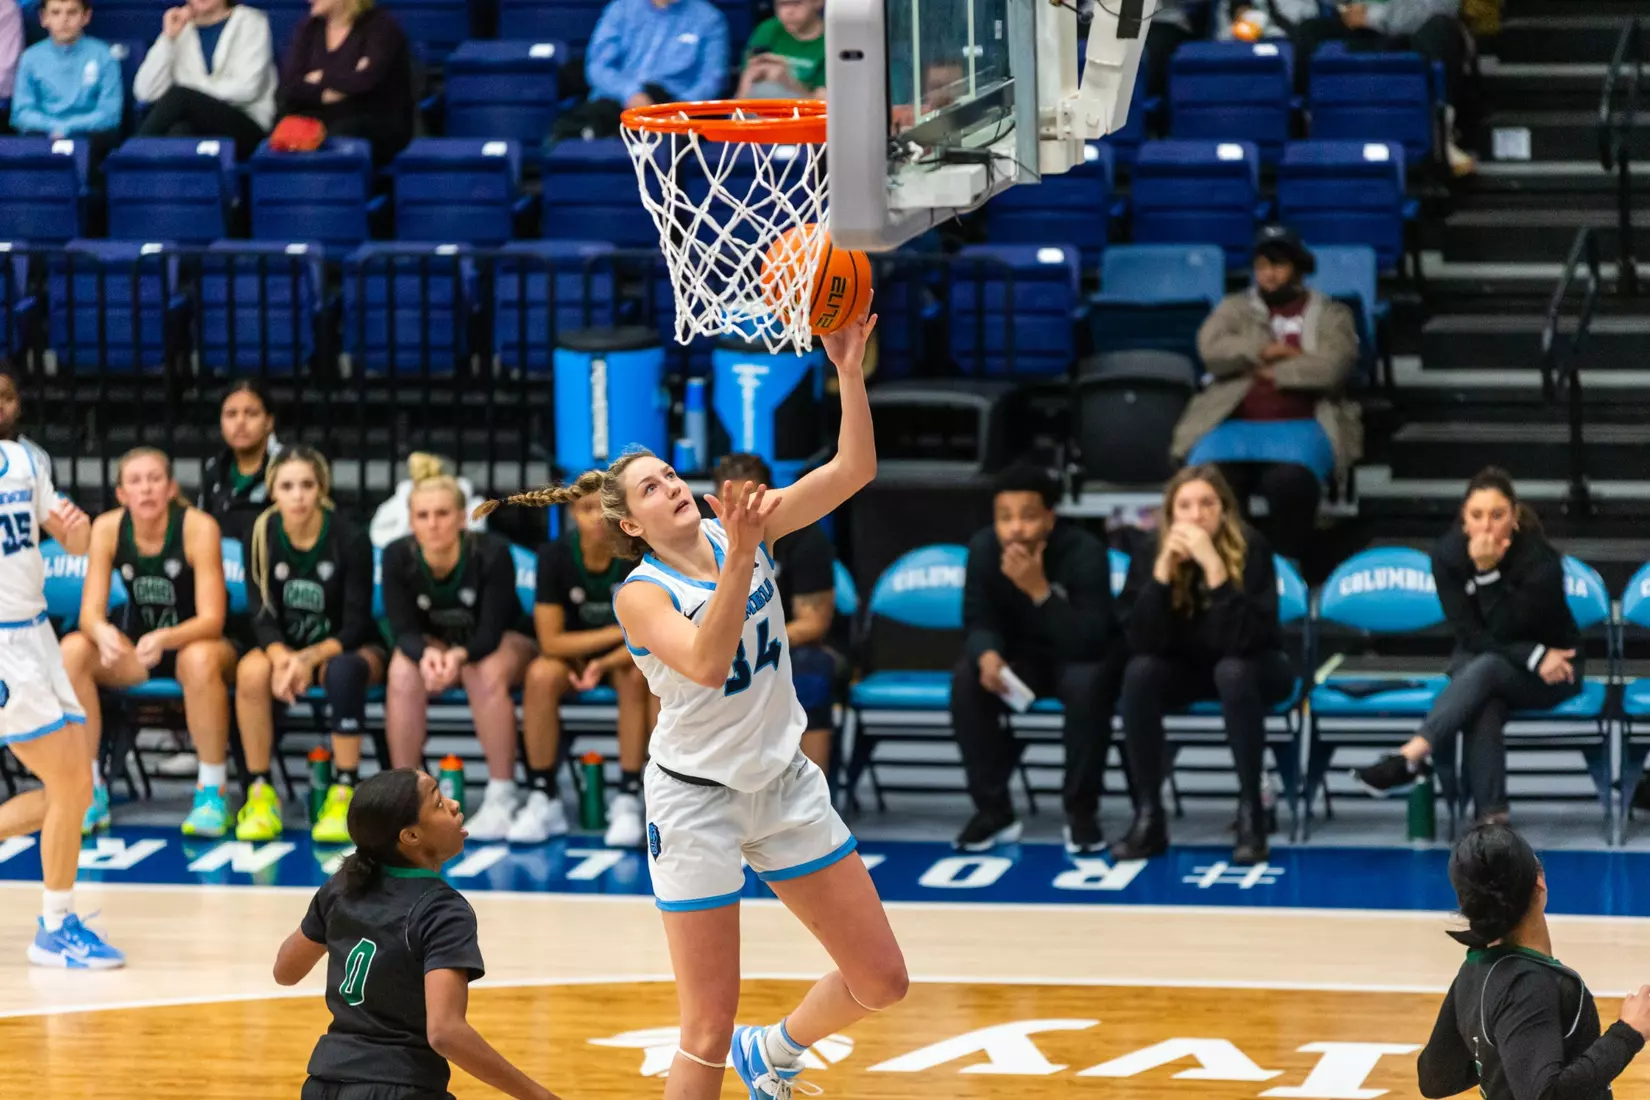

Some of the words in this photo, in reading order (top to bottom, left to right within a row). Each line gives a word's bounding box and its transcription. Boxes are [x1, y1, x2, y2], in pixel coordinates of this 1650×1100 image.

[815, 275, 846, 328] ELITE
[1339, 566, 1438, 596] COLUMBIA
[724, 616, 782, 697] 34
[339, 937, 376, 1006] 0
[866, 1018, 1423, 1099] IVY
